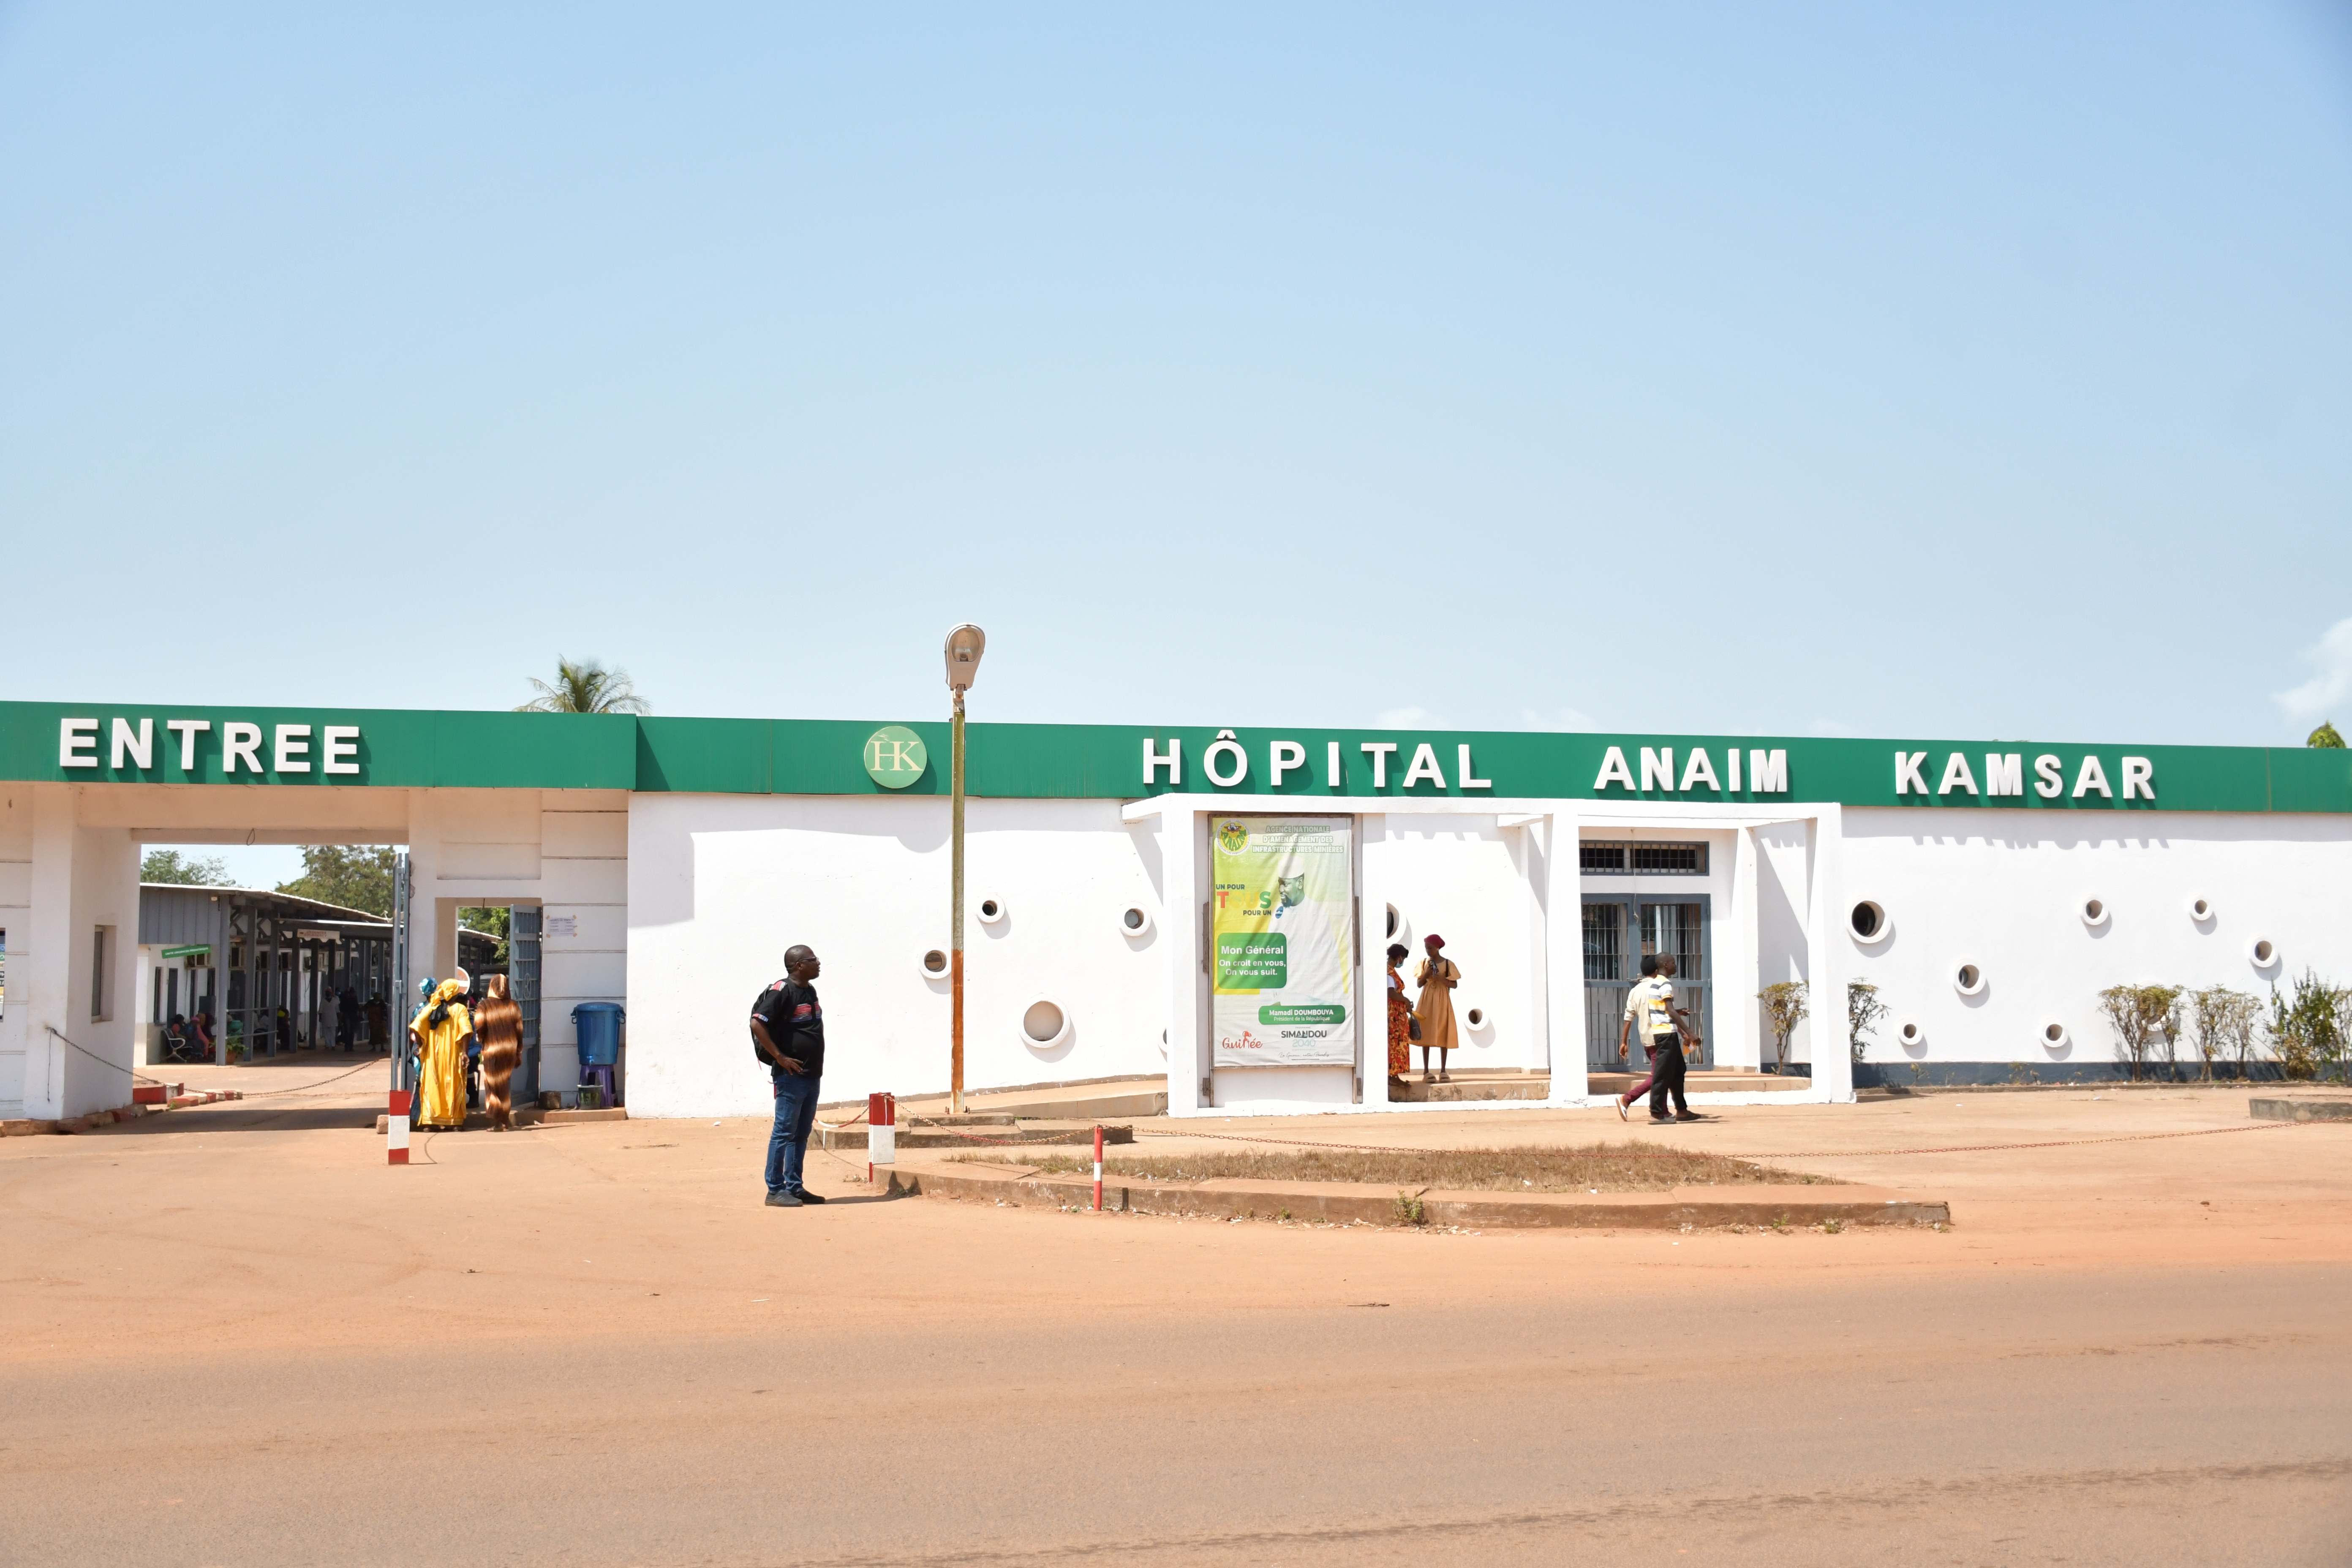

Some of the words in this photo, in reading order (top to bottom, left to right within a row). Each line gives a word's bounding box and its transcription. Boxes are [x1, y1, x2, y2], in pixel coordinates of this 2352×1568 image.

[60, 718, 359, 774] ENTREE
[871, 741, 923, 771] HK
[1143, 730, 1492, 789] HÔPITAL
[1593, 746, 1788, 792] ANAIM
[1895, 752, 2155, 800] KAMSAR
[1313, 844, 1344, 853] MINIÈRES
[1217, 891, 1271, 909] TOUS
[1221, 946, 1242, 954] Mon
[1245, 946, 1284, 954] Général
[1222, 1031, 1263, 1049] Guinée
[1281, 1030, 1327, 1038] SIMANDOU
[1292, 1039, 1316, 1047] 2040
